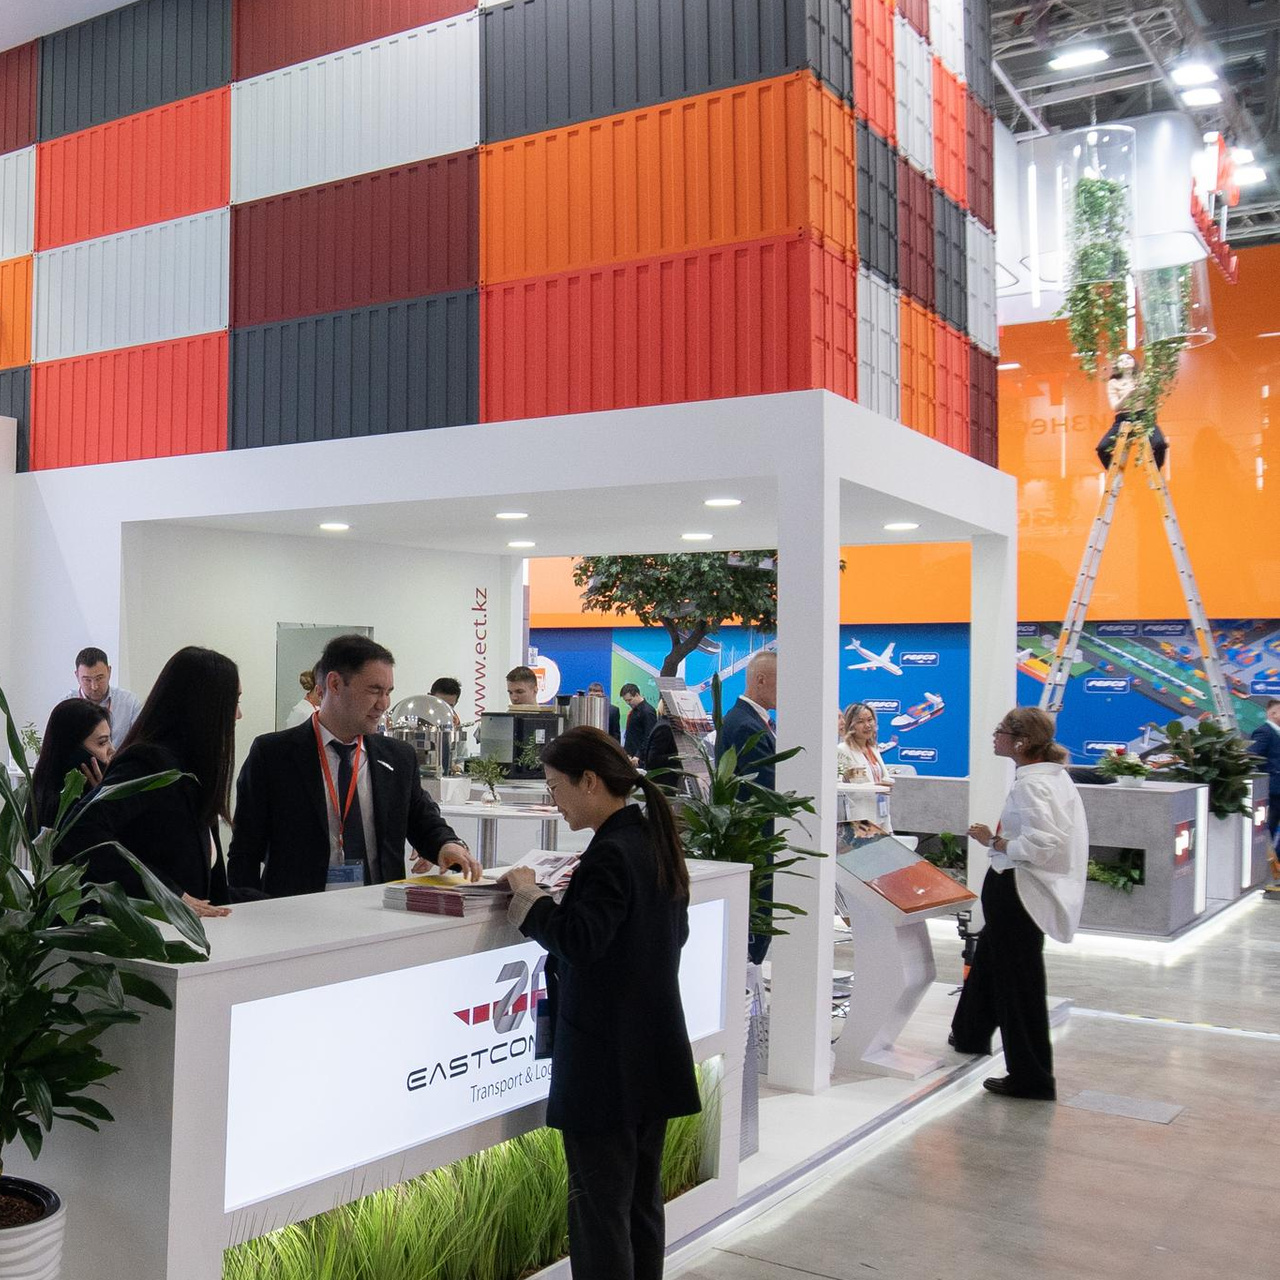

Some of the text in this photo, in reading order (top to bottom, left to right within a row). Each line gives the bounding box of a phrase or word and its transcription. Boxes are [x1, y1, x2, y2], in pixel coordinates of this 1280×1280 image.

[471, 587, 488, 724] www.ect.kz
[471, 1071, 523, 1103] Transport
[524, 1066, 534, 1084] &
